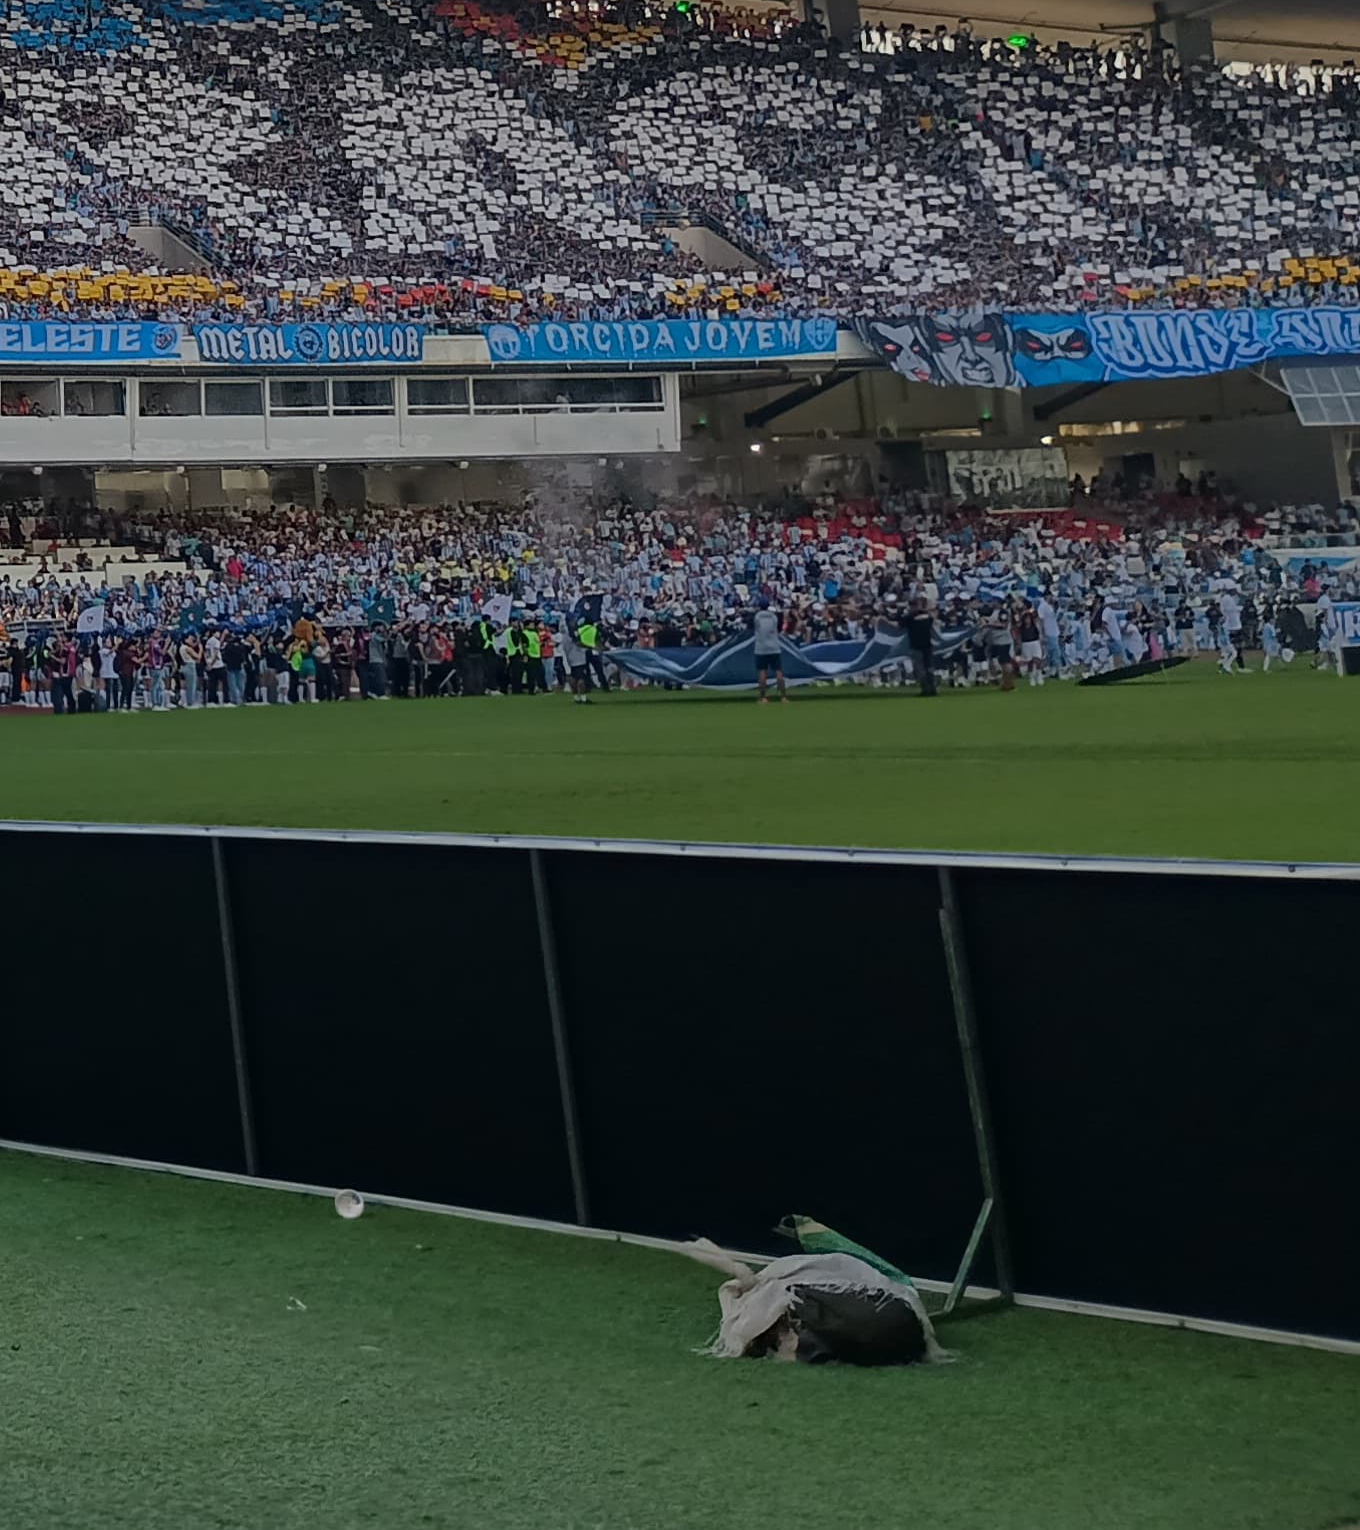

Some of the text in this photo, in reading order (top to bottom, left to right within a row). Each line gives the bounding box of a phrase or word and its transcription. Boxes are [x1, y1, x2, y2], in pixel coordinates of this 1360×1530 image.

[198, 325, 420, 360] METAL BICOLOR
[522, 319, 802, 358] TORCIDA JOVEM
